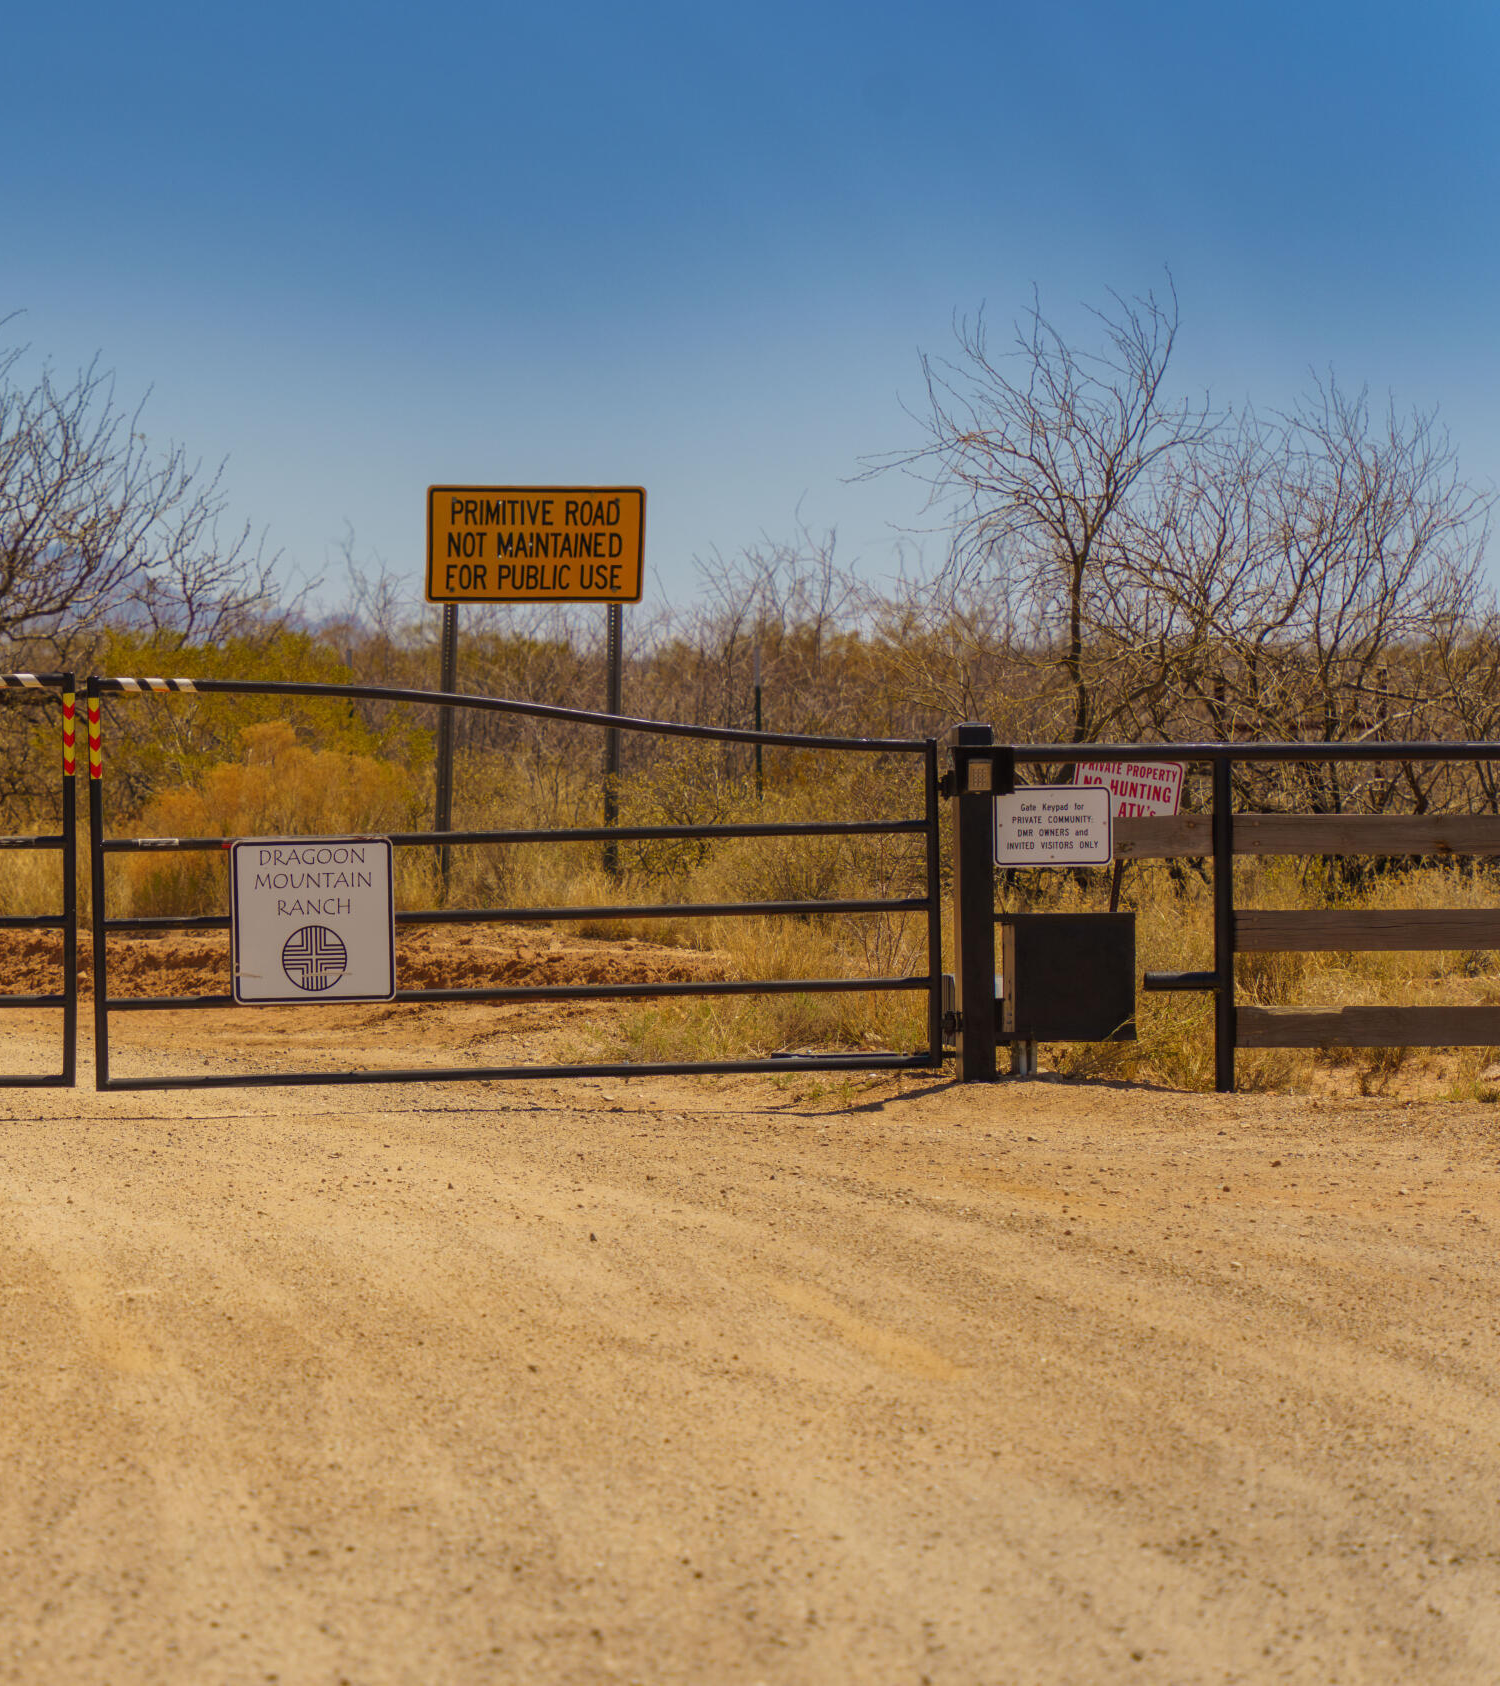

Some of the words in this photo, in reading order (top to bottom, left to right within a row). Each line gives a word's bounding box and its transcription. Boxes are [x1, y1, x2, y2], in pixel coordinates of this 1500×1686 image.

[451, 499, 554, 526] PRIMITIVE
[565, 499, 621, 527] ROAD
[447, 532, 487, 558] NOT
[497, 532, 622, 558] MAINTAINED
[446, 564, 487, 590] FOR
[497, 564, 571, 590] PUBLIC
[580, 564, 622, 590] USE
[1126, 764, 1178, 783] PROPERTY
[1110, 779, 1172, 803] HUNTING
[1020, 803, 1037, 812] Gate
[1042, 803, 1069, 813] Keypad
[1074, 803, 1085, 811] for
[1012, 815, 1042, 824] PRIVATE
[1017, 829, 1034, 837] DMR
[1039, 828, 1070, 837] OWNERS
[1075, 828, 1089, 836] and
[1006, 841, 1035, 850] INVITED
[1041, 841, 1074, 850] VISITORS
[1079, 841, 1099, 849] ONLY
[259, 848, 365, 866] DRAGOON
[254, 872, 372, 890] MOUNTAIN
[277, 898, 351, 916] RANCH
